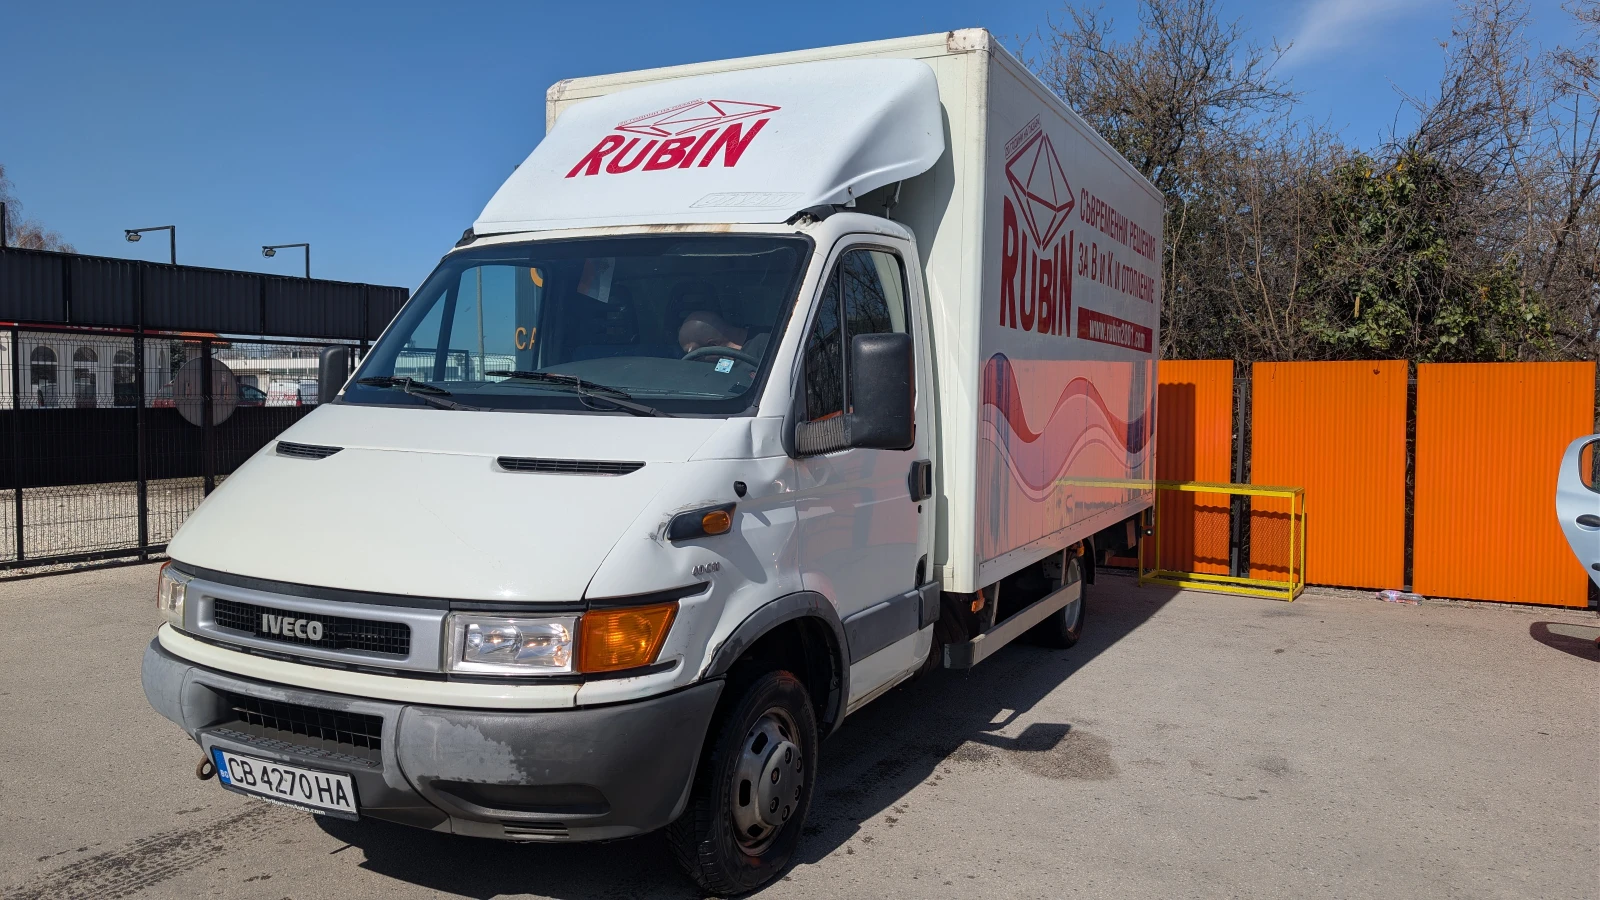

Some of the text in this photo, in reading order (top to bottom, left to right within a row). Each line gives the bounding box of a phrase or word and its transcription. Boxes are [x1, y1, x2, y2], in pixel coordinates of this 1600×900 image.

[564, 117, 770, 178] RUBIN
[1080, 187, 1156, 263] СЪВРЕМЕННИ РЕШЕНИЯ
[1000, 194, 1074, 338] RUBIN
[1078, 242, 1089, 278] ЗА
[1092, 241, 1098, 281] В
[1107, 250, 1114, 288] К
[1122, 265, 1155, 304] ОТОПЛЕНИЕ
[1089, 319, 1146, 349] www.rubin2001.com
[262, 613, 323, 641] IVECO
[220, 769, 230, 778] BG
[228, 757, 351, 807] CB 4270 HA
